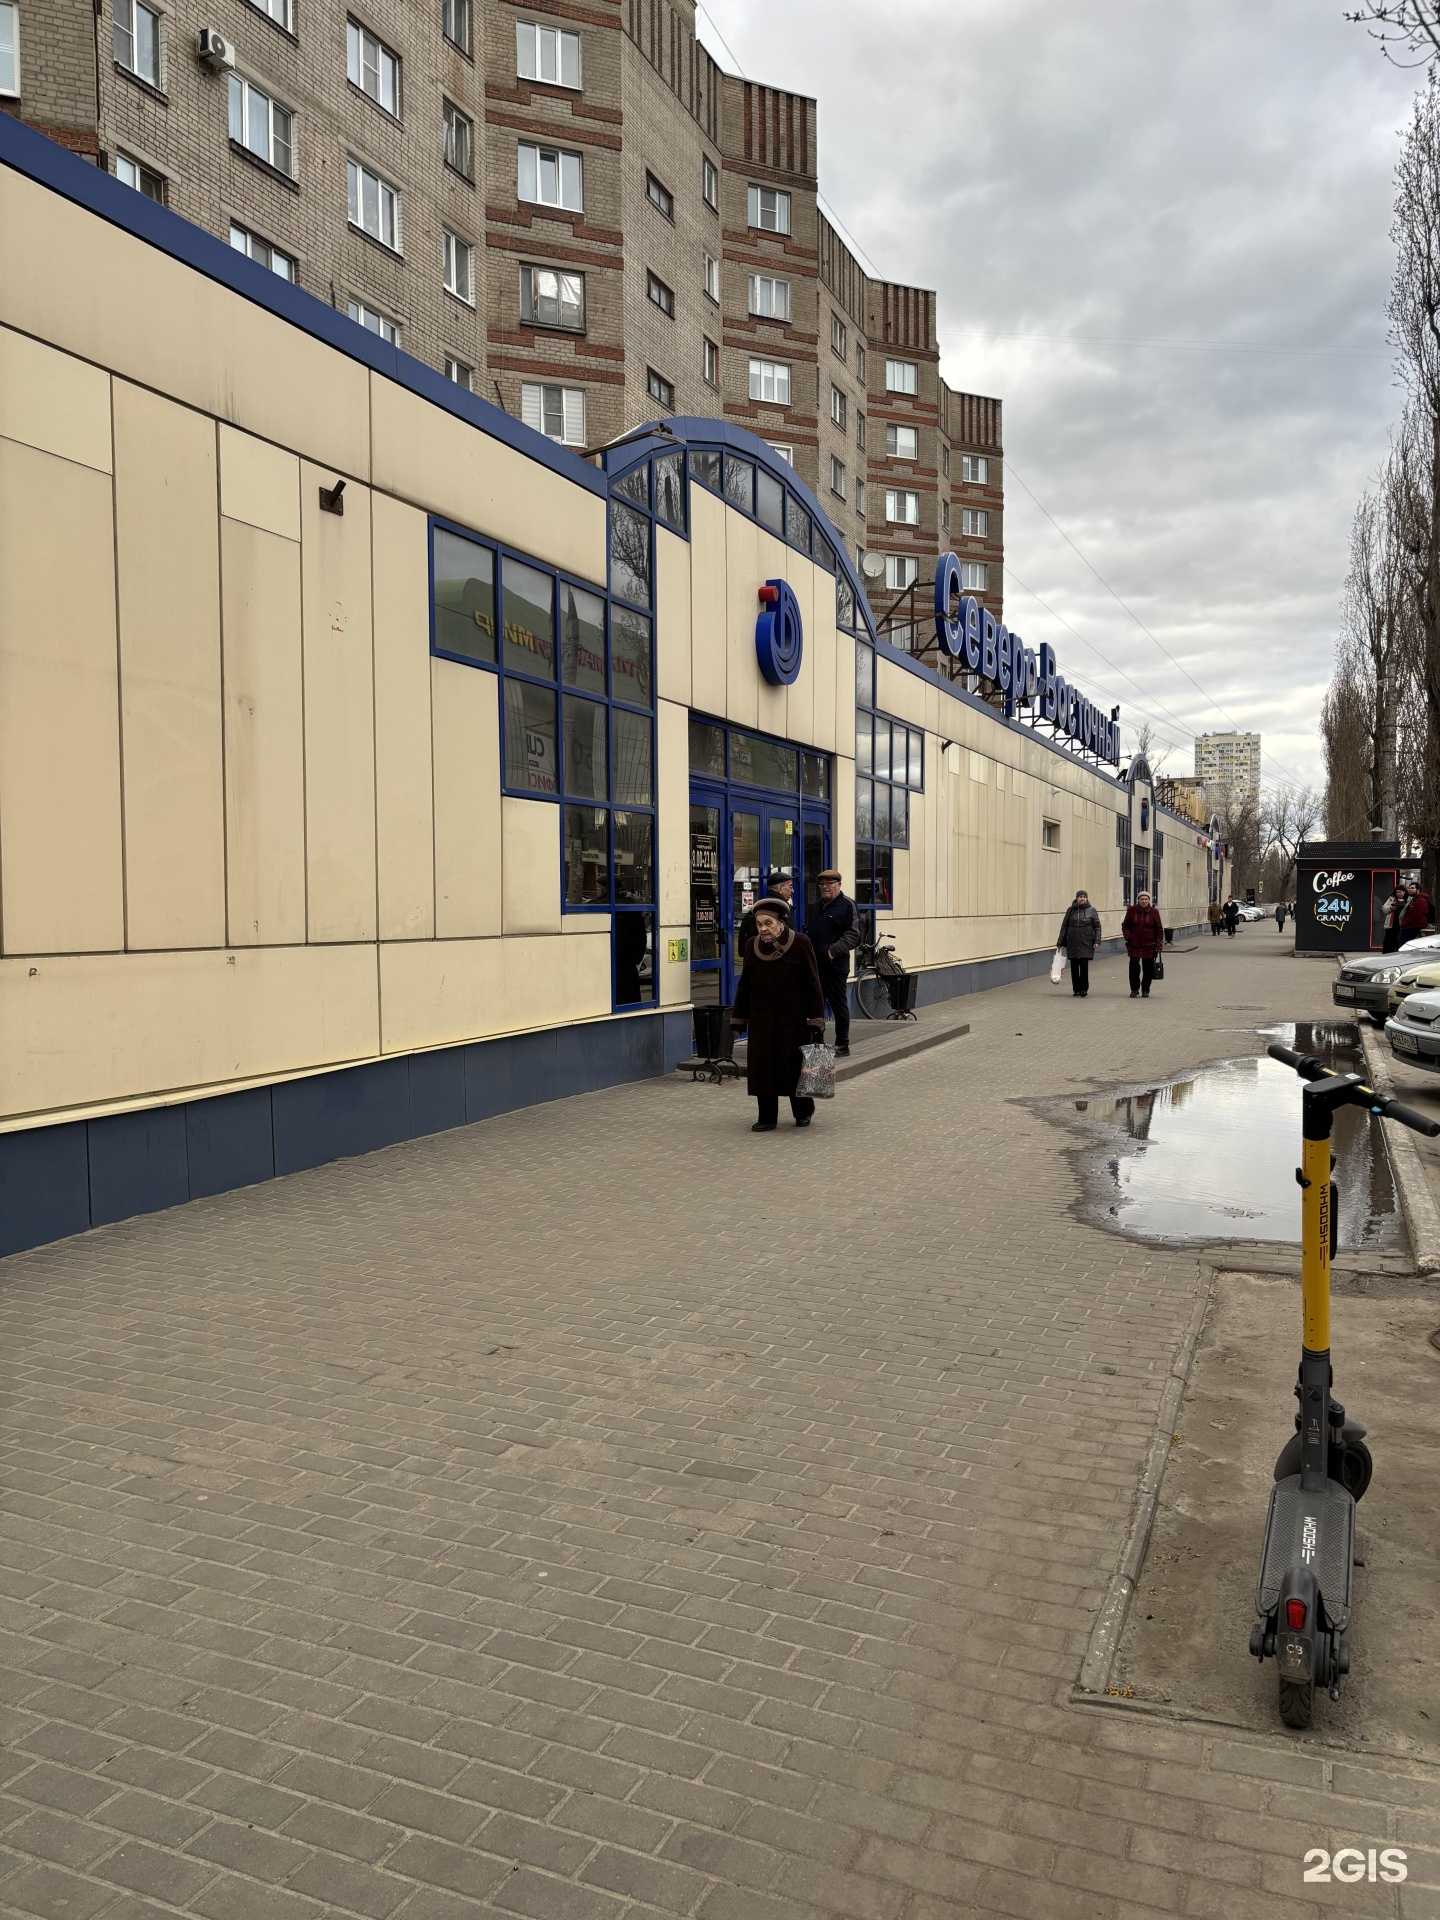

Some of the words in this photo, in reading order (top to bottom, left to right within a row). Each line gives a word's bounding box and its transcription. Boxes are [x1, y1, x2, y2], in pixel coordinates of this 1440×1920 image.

[1313, 871, 1354, 892] Coffee
[1319, 1183, 1329, 1245] WHOOSH
[1302, 1516, 1317, 1550] WHOOSH
